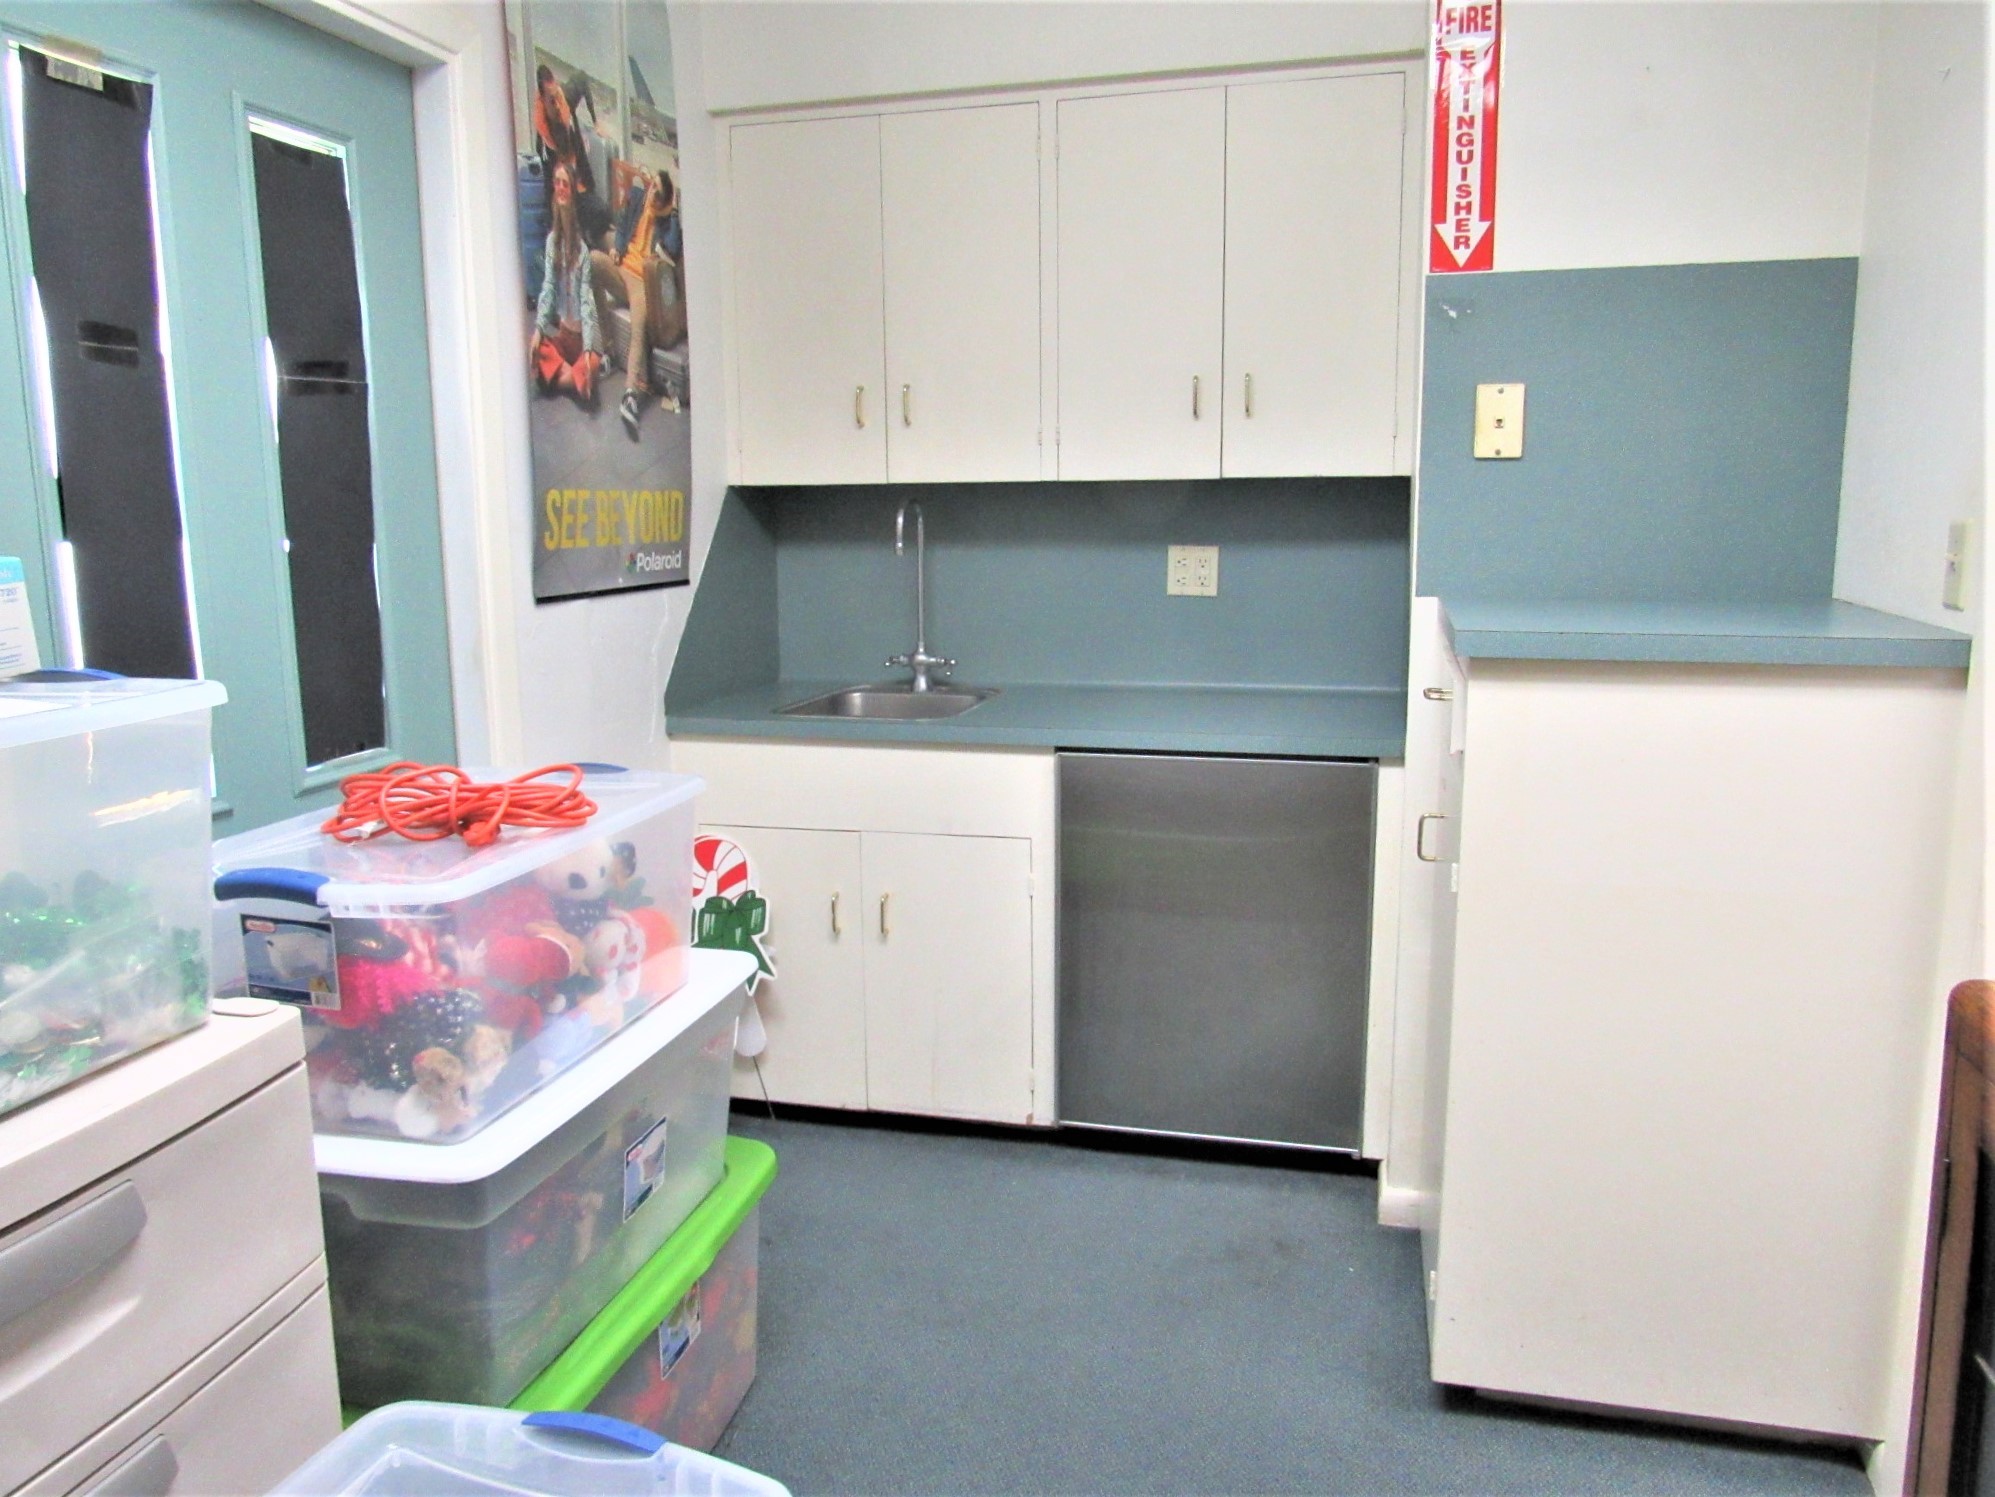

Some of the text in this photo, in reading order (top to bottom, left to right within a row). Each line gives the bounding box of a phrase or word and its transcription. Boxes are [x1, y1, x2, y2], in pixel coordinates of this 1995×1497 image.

[1445, 5, 1492, 34] FIRE
[1453, 47, 1476, 250] EXTINGUISHER
[544, 488, 684, 550] SEE BEYOND
[636, 551, 682, 572] Polaroid
